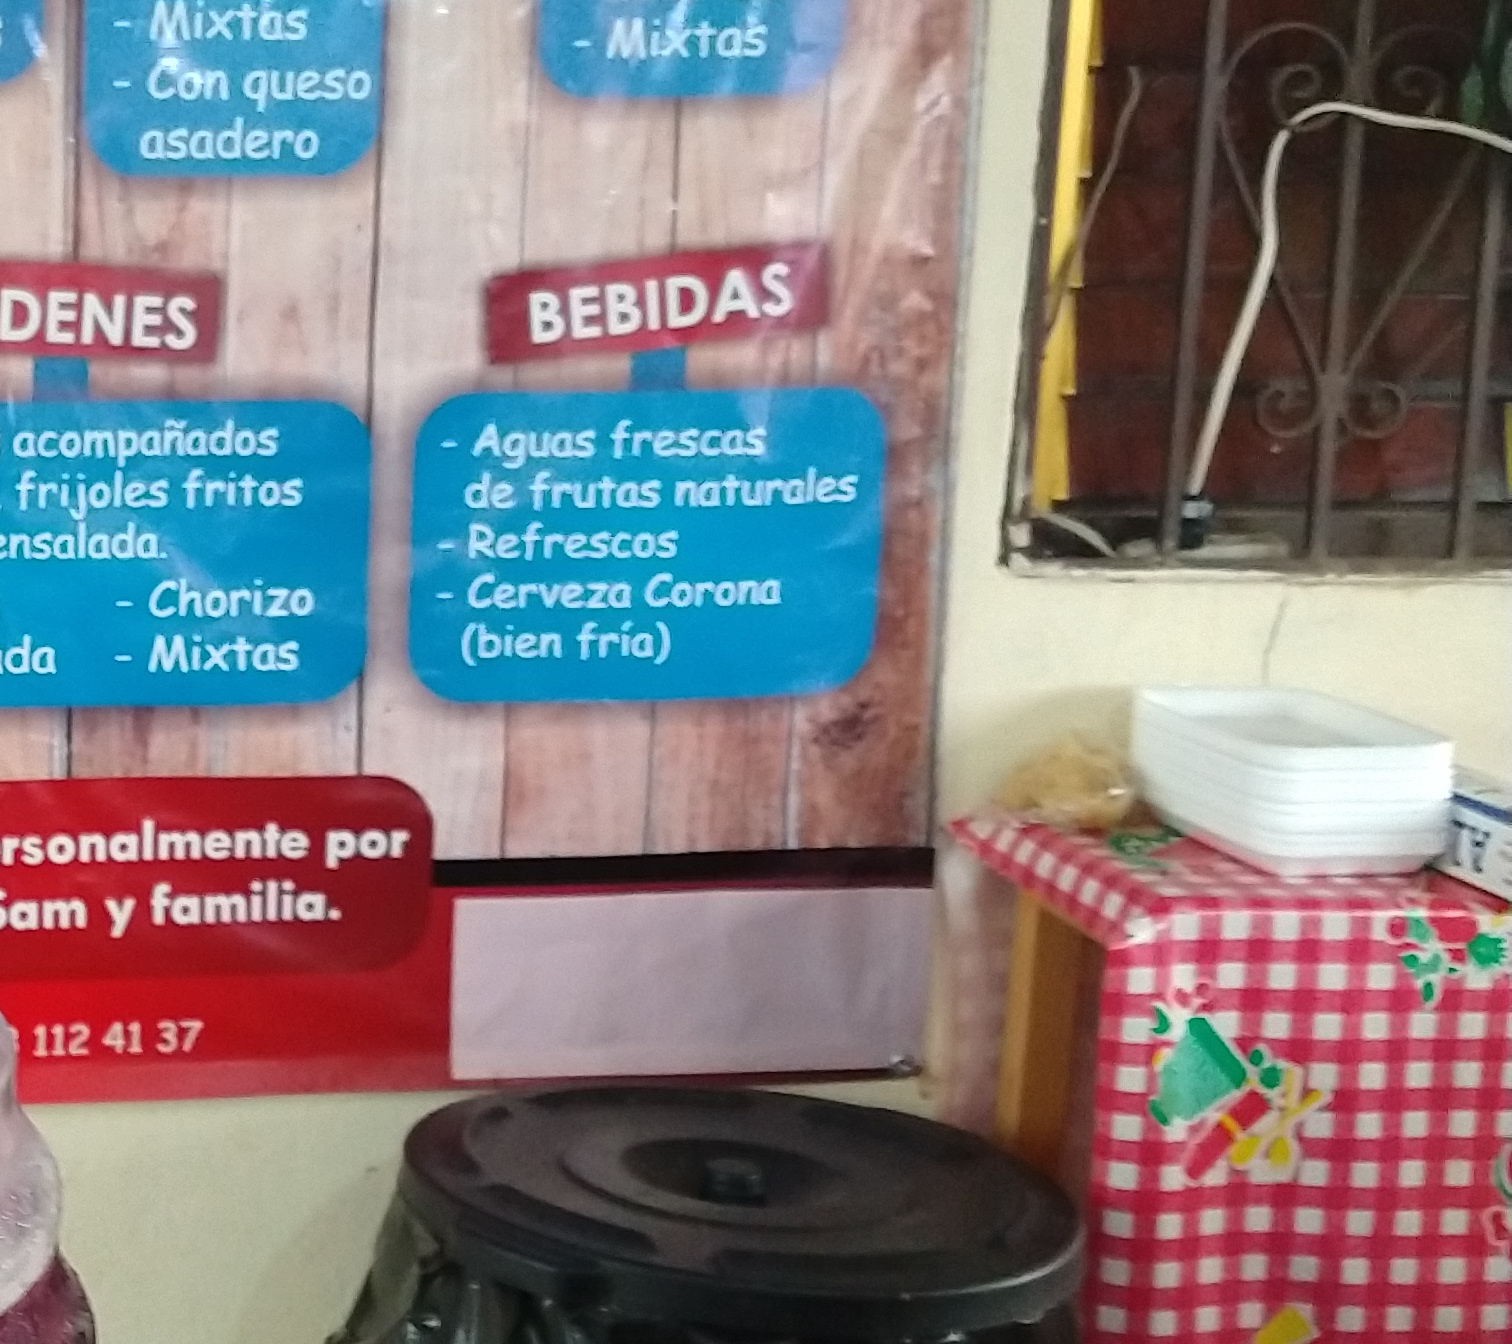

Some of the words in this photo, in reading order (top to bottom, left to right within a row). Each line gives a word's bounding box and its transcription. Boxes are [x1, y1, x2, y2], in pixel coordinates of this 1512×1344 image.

[606, 17, 767, 58] Mixtas
[147, 58, 229, 101] Con
[244, 67, 371, 112] queso
[139, 118, 319, 160] asadero
[528, 261, 792, 344] BEBIDAS
[12, 418, 280, 467] acompañados
[471, 422, 596, 469] Aguas
[612, 419, 766, 458] frescas
[15, 470, 168, 520] frijoles
[182, 469, 303, 509] fritos
[464, 473, 515, 511] de
[530, 471, 661, 511] frutas
[673, 466, 858, 506] naturales
[467, 522, 678, 560] Refrescos
[148, 578, 315, 619] Chorizo
[467, 573, 631, 610] Cerveza
[645, 573, 781, 607] Corona
[148, 634, 300, 673] Mixtas
[460, 622, 562, 667] (bien
[577, 620, 672, 665] fría)
[324, 828, 411, 868] por
[104, 893, 135, 937] y
[150, 879, 341, 925] familia.
[32, 1022, 90, 1057] 112
[101, 1021, 143, 1054] 41
[156, 1019, 204, 1052] 37
